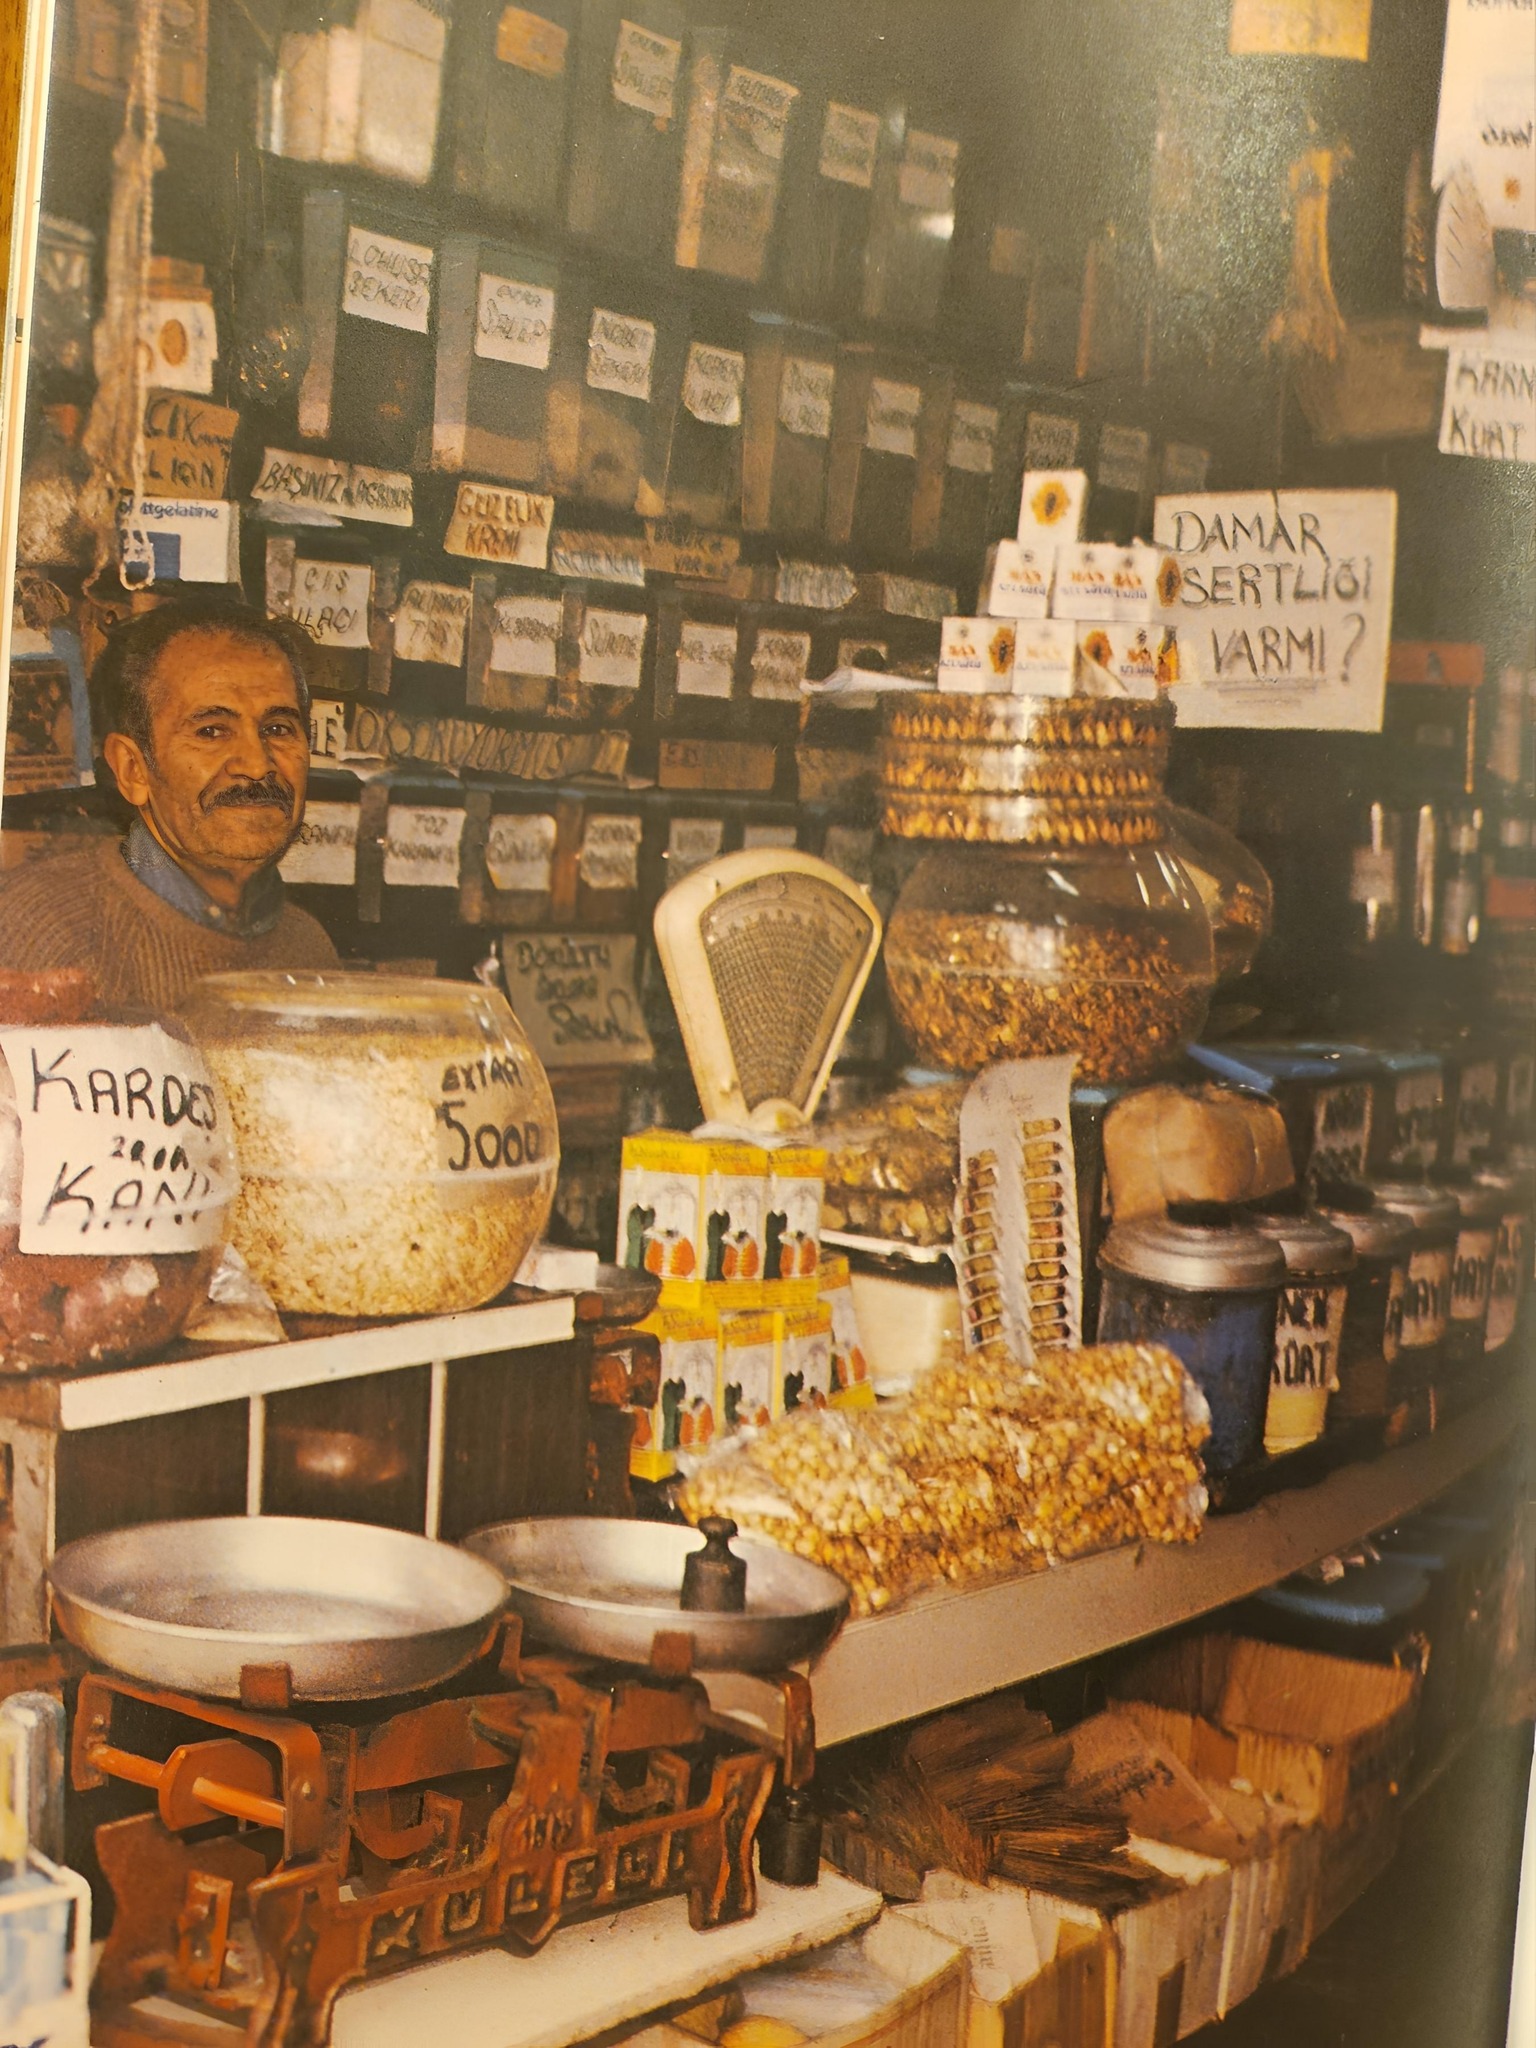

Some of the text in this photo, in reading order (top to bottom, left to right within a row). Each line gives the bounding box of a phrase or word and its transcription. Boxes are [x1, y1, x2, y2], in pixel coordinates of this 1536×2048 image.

[1171, 510, 1331, 560] DAMAR
[1211, 624, 1327, 678] VARMI
[435, 1097, 541, 1171] 5000
